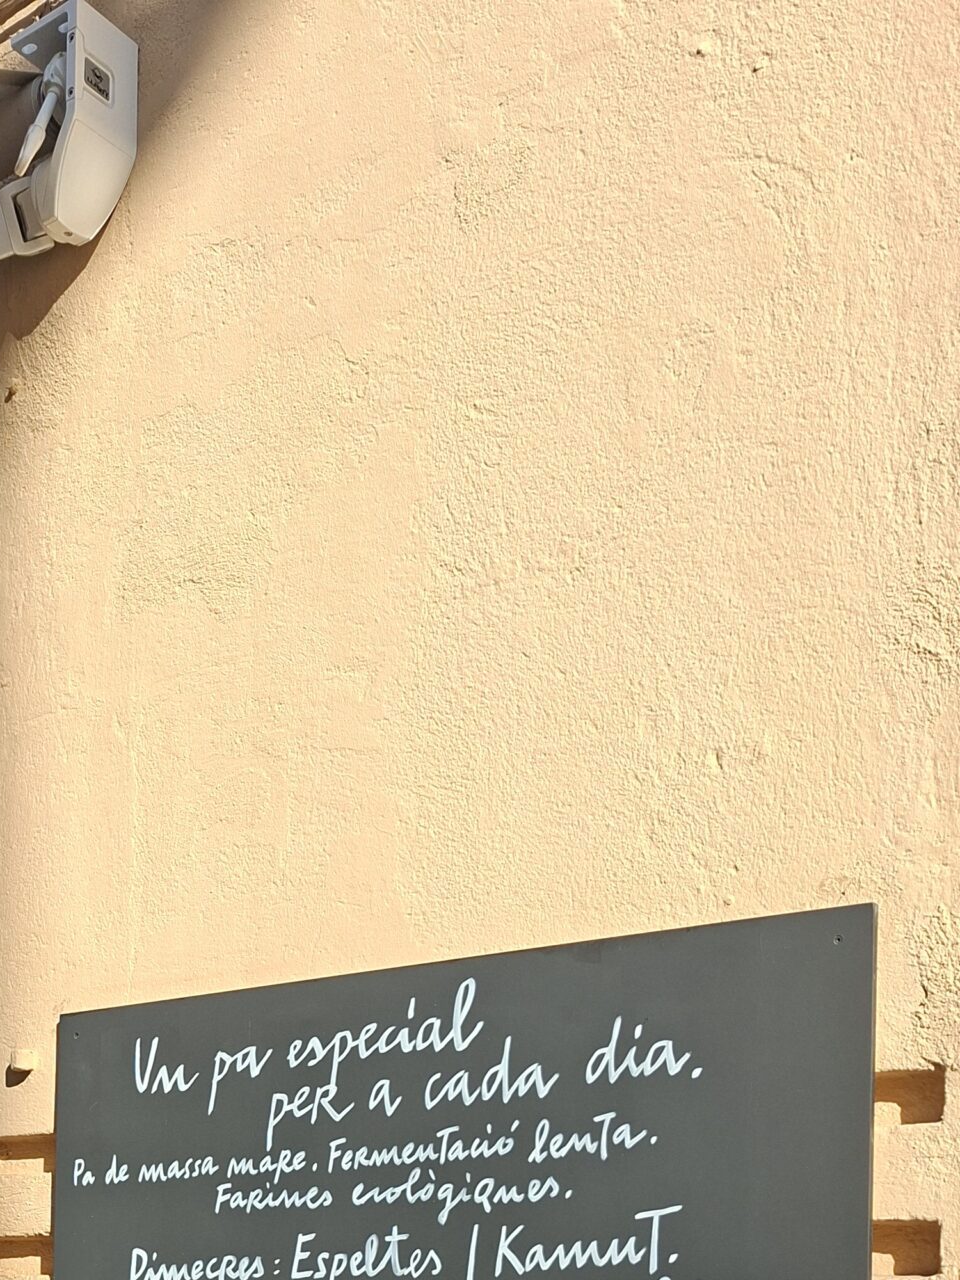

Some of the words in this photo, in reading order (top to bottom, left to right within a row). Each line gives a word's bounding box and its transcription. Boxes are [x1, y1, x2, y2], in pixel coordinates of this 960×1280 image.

[133, 1037, 199, 1094] Un
[207, 1042, 273, 1115] pa
[287, 977, 485, 1082] especial
[369, 1078, 402, 1117] a
[425, 1037, 560, 1109] cada
[586, 1016, 704, 1085] dia.
[73, 1158, 96, 1187] Pa
[104, 1154, 130, 1185] de
[138, 1156, 220, 1184] massa
